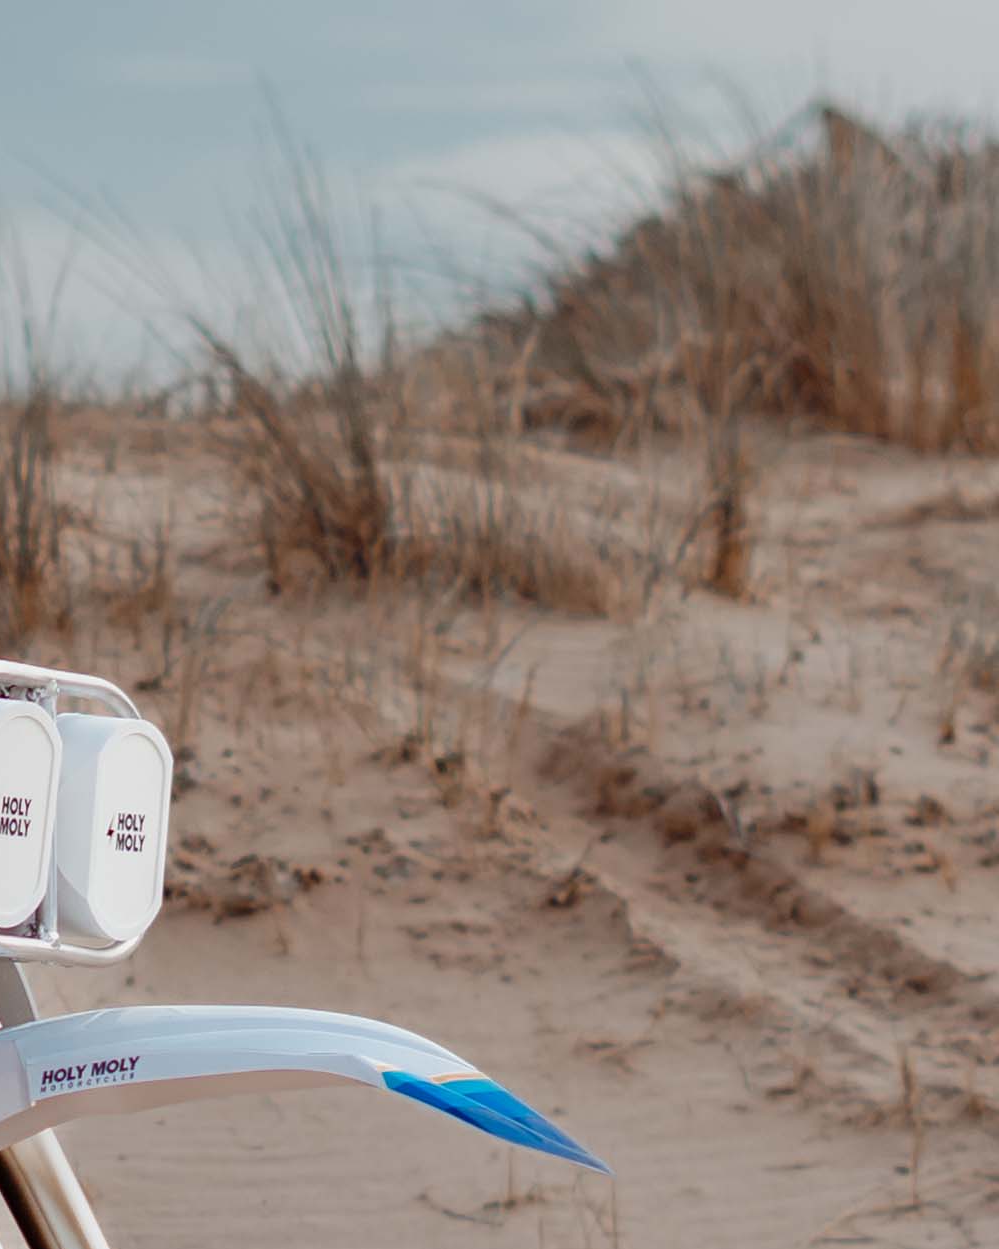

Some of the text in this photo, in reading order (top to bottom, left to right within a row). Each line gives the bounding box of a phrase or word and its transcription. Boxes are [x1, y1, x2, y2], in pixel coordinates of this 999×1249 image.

[1, 796, 32, 817] HOLY
[0, 816, 31, 837] MOLY
[117, 813, 145, 832] HOLY
[115, 833, 145, 852] MOLY
[42, 1056, 140, 1085] HOLY MOLY
[40, 1072, 135, 1093] MOTORCYCLES
